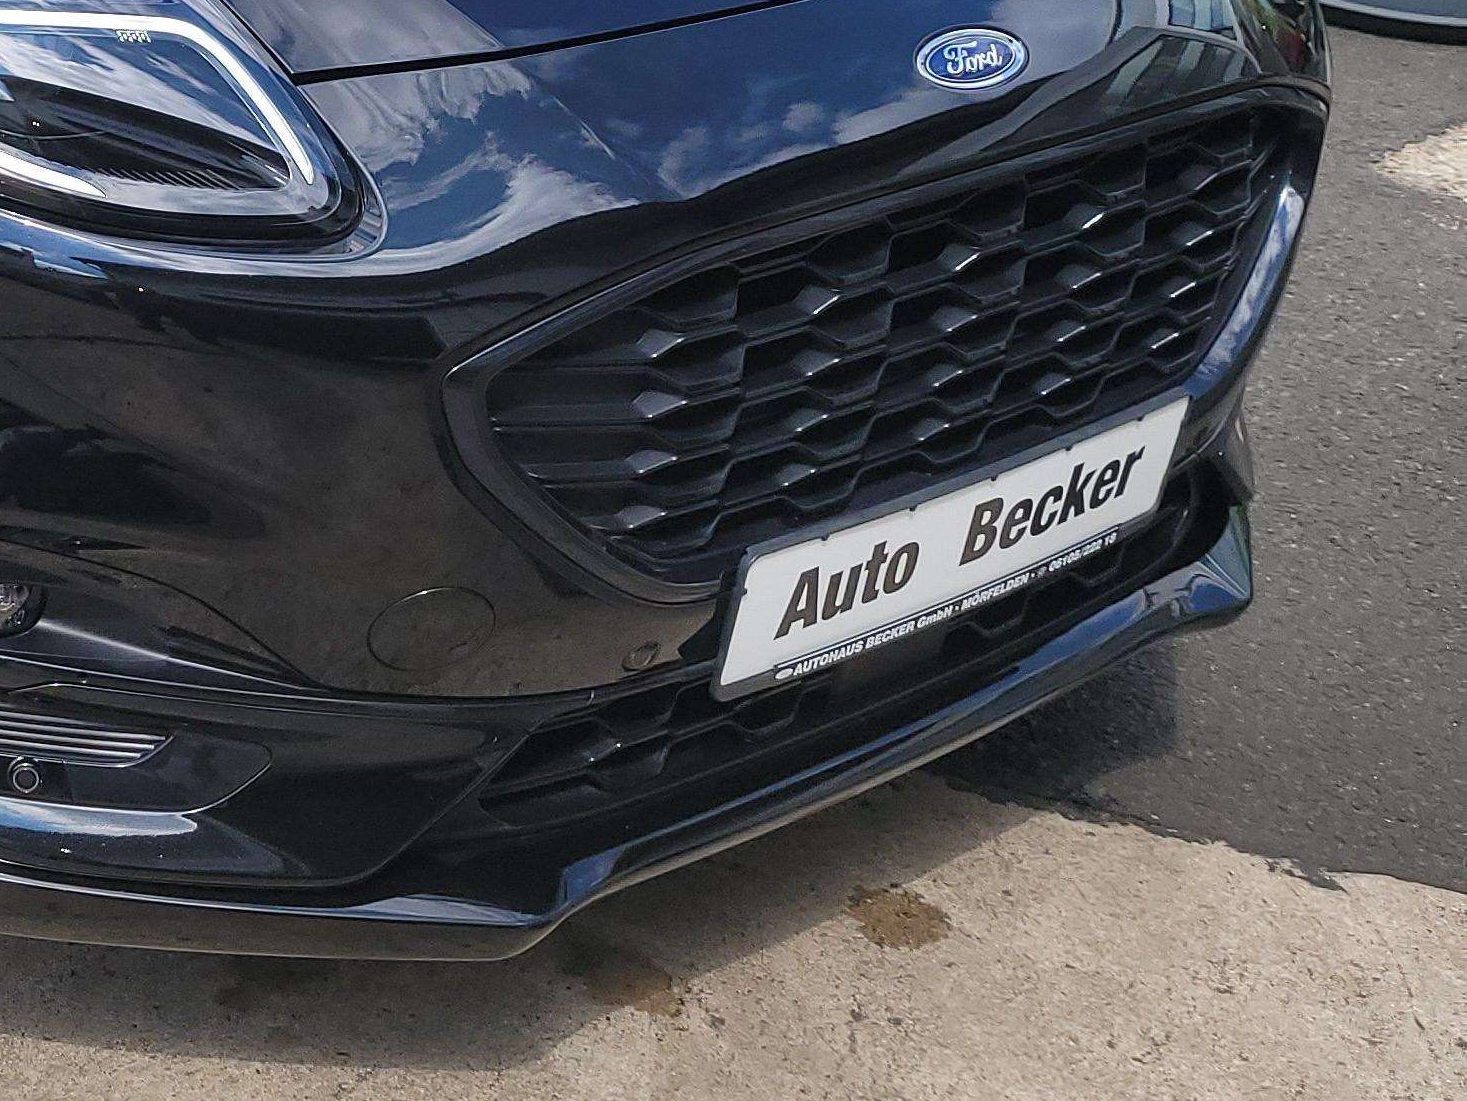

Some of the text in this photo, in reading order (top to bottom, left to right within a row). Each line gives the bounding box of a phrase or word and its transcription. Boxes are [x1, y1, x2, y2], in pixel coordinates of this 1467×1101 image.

[943, 40, 1003, 75] Ford
[773, 445, 1146, 640] Auto Becker
[792, 640, 864, 676] AUTOHAUS
[865, 620, 916, 649] BECKER
[917, 605, 952, 628] GmbH
